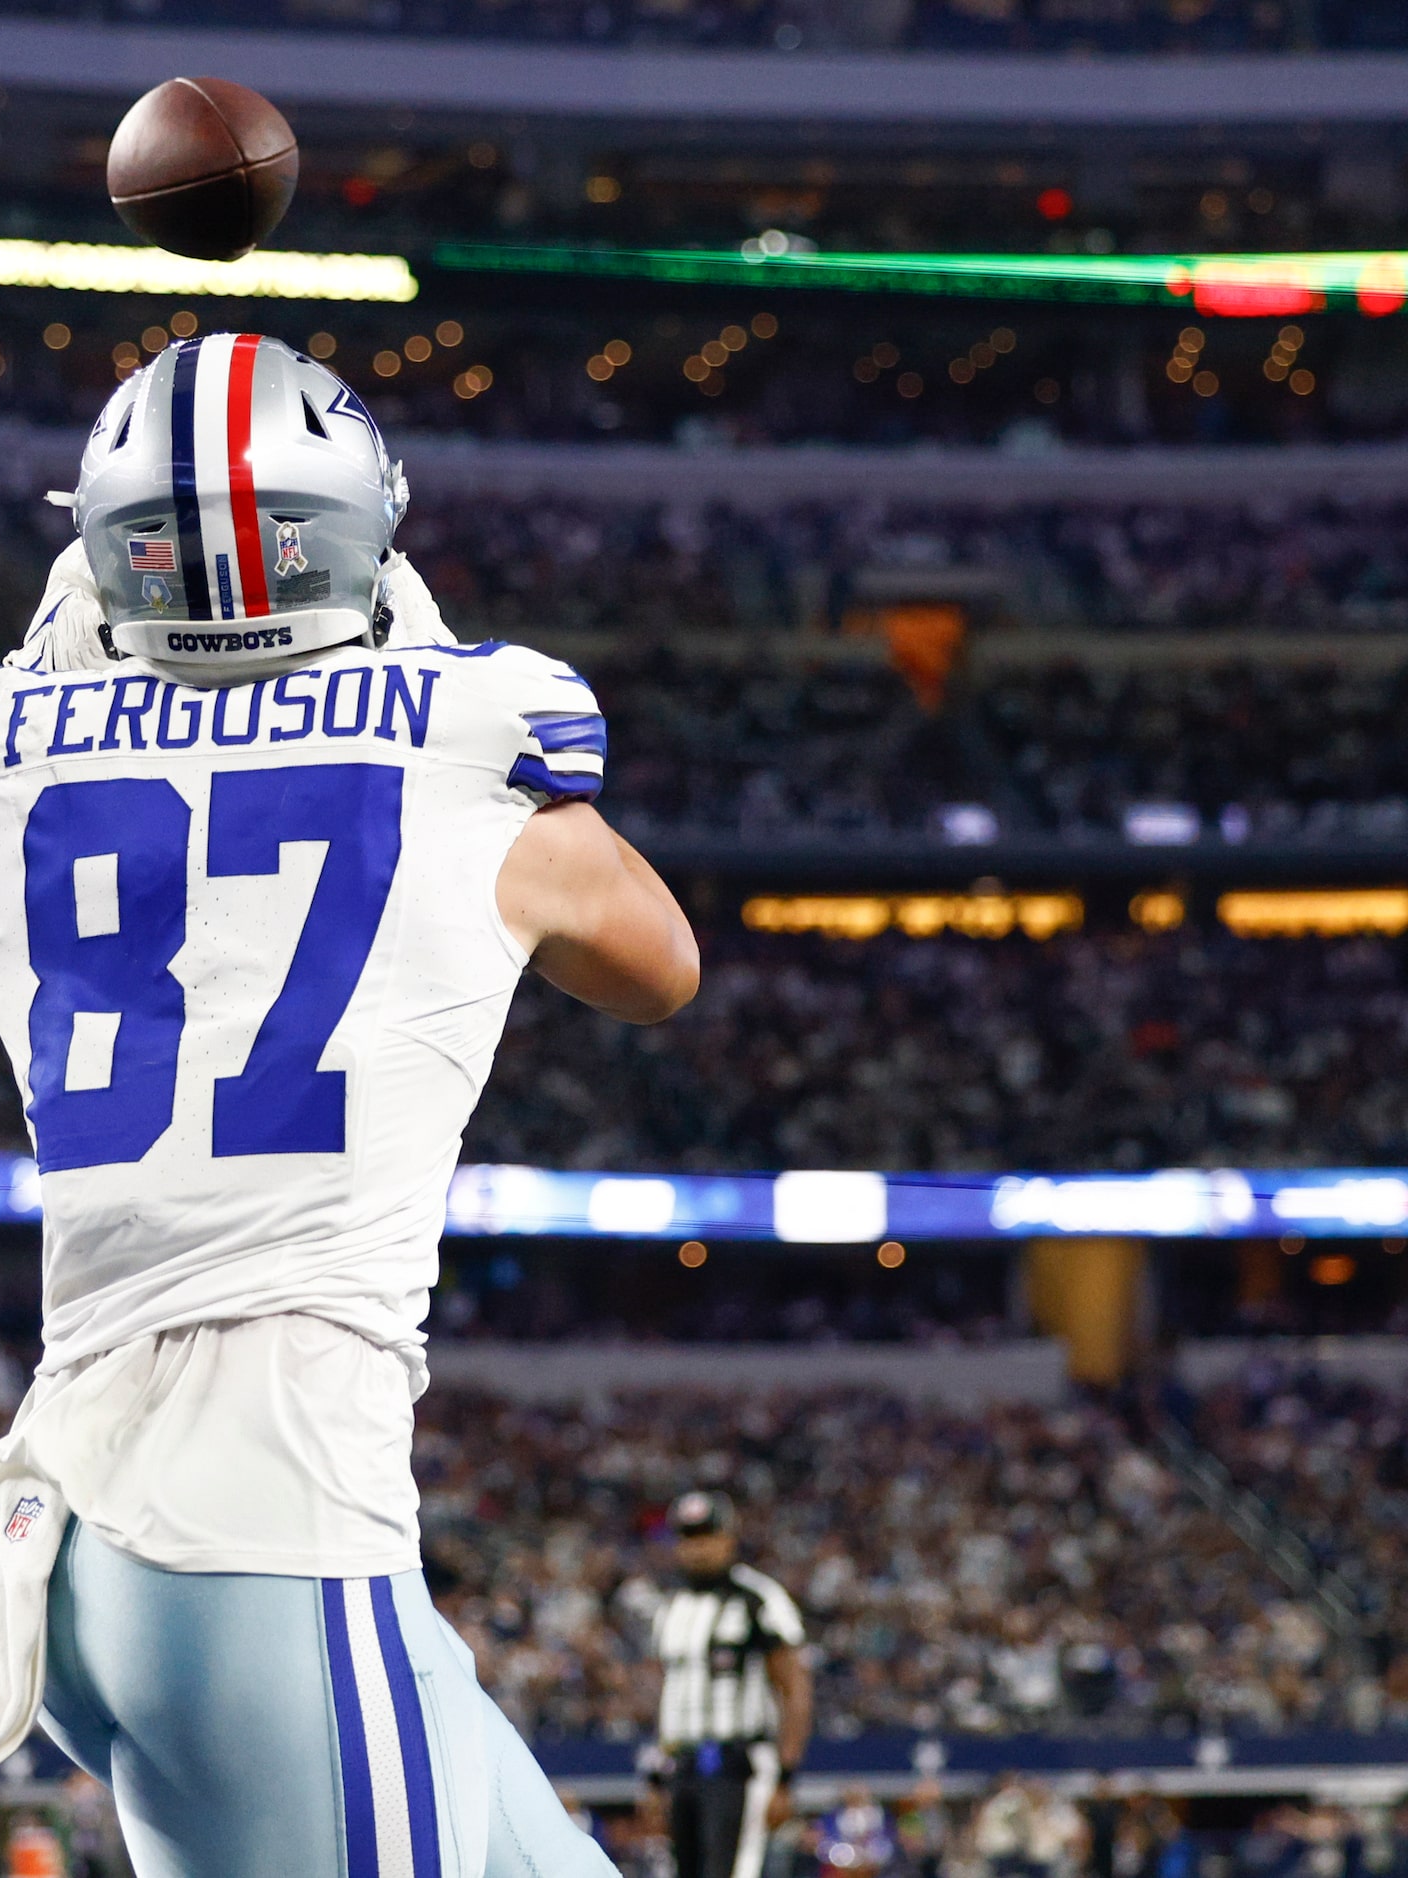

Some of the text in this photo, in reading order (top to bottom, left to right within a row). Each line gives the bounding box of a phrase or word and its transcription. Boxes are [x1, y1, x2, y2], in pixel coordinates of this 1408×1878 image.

[282, 546, 299, 560] NFL
[217, 555, 231, 613] FERGUSON
[168, 626, 293, 653] COWBOYS
[3, 665, 441, 768] FERGUSON
[22, 763, 405, 1174] 87
[7, 1513, 32, 1538] NFL
